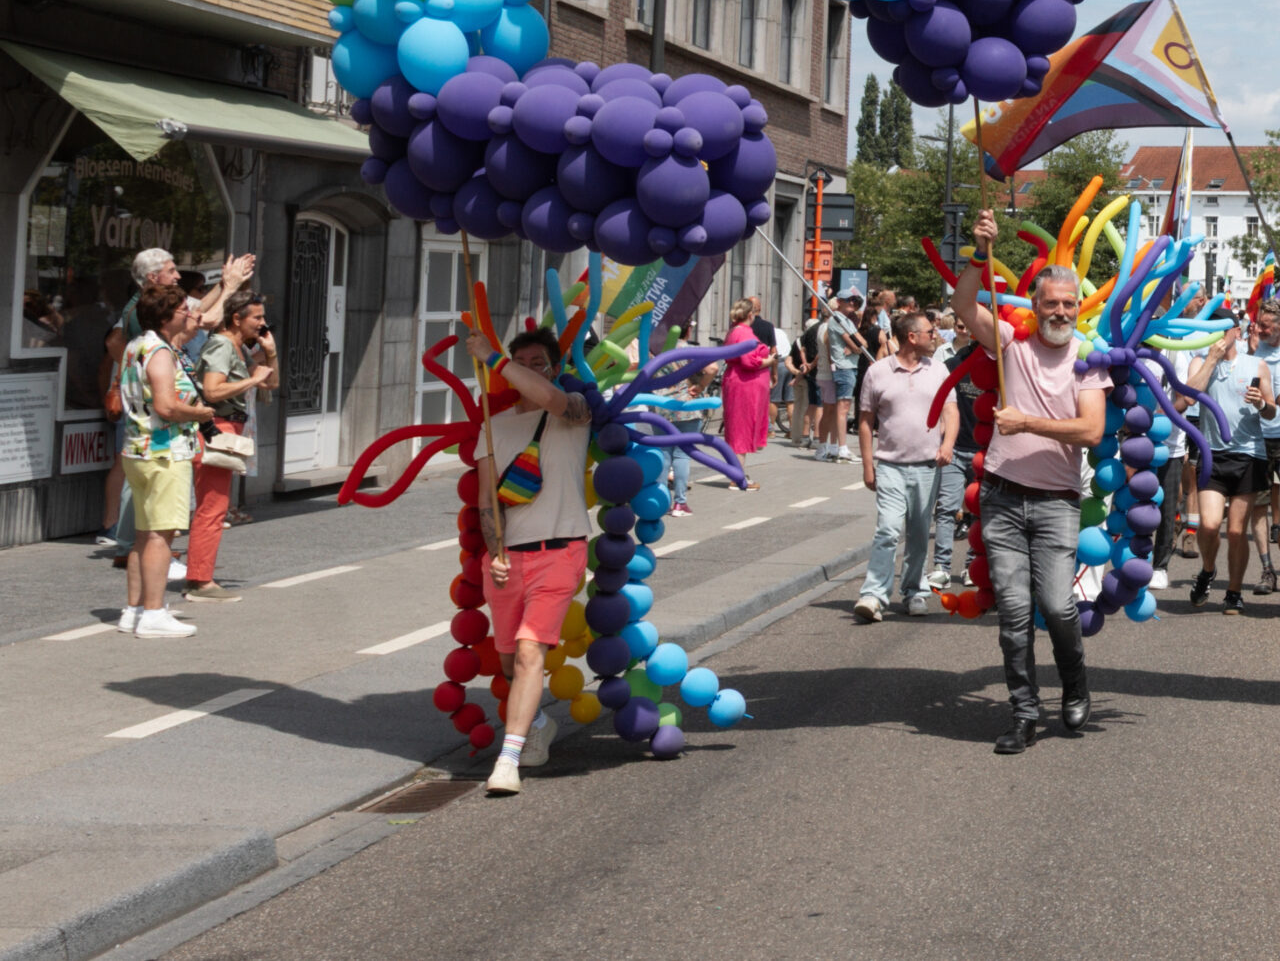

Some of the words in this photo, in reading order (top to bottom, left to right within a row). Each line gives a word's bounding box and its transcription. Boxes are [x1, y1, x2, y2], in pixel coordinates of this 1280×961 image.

[75, 155, 133, 178] Bloesem
[136, 159, 194, 192] Remedies
[90, 204, 175, 250] Yarrow
[64, 431, 110, 466] WINKEL
